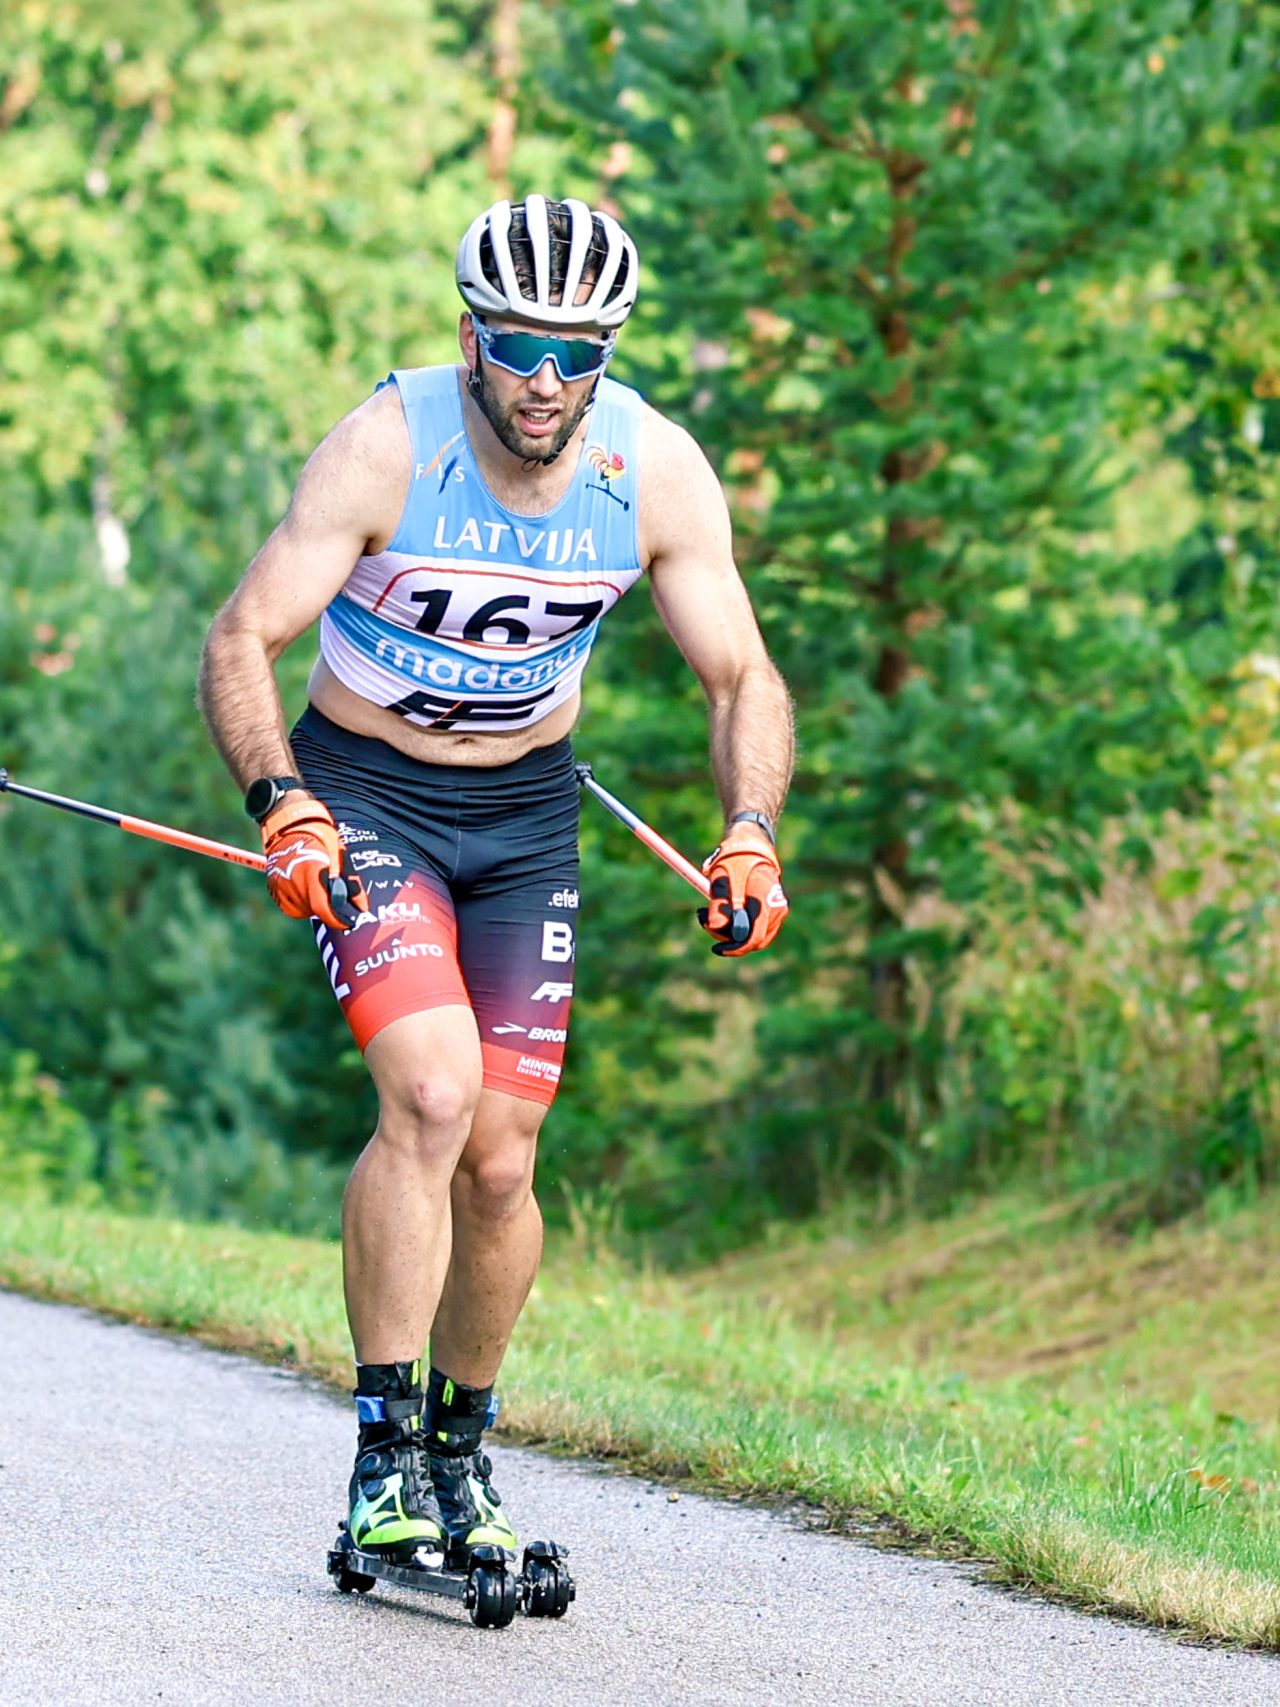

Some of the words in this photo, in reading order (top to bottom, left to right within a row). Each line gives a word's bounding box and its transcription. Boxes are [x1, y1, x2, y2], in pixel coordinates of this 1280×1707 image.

[416, 463, 465, 484] FIS
[433, 516, 597, 565] LATVIJA
[410, 589, 603, 645] 167
[344, 902, 420, 936] AKU
[354, 943, 443, 976] SUUNTO
